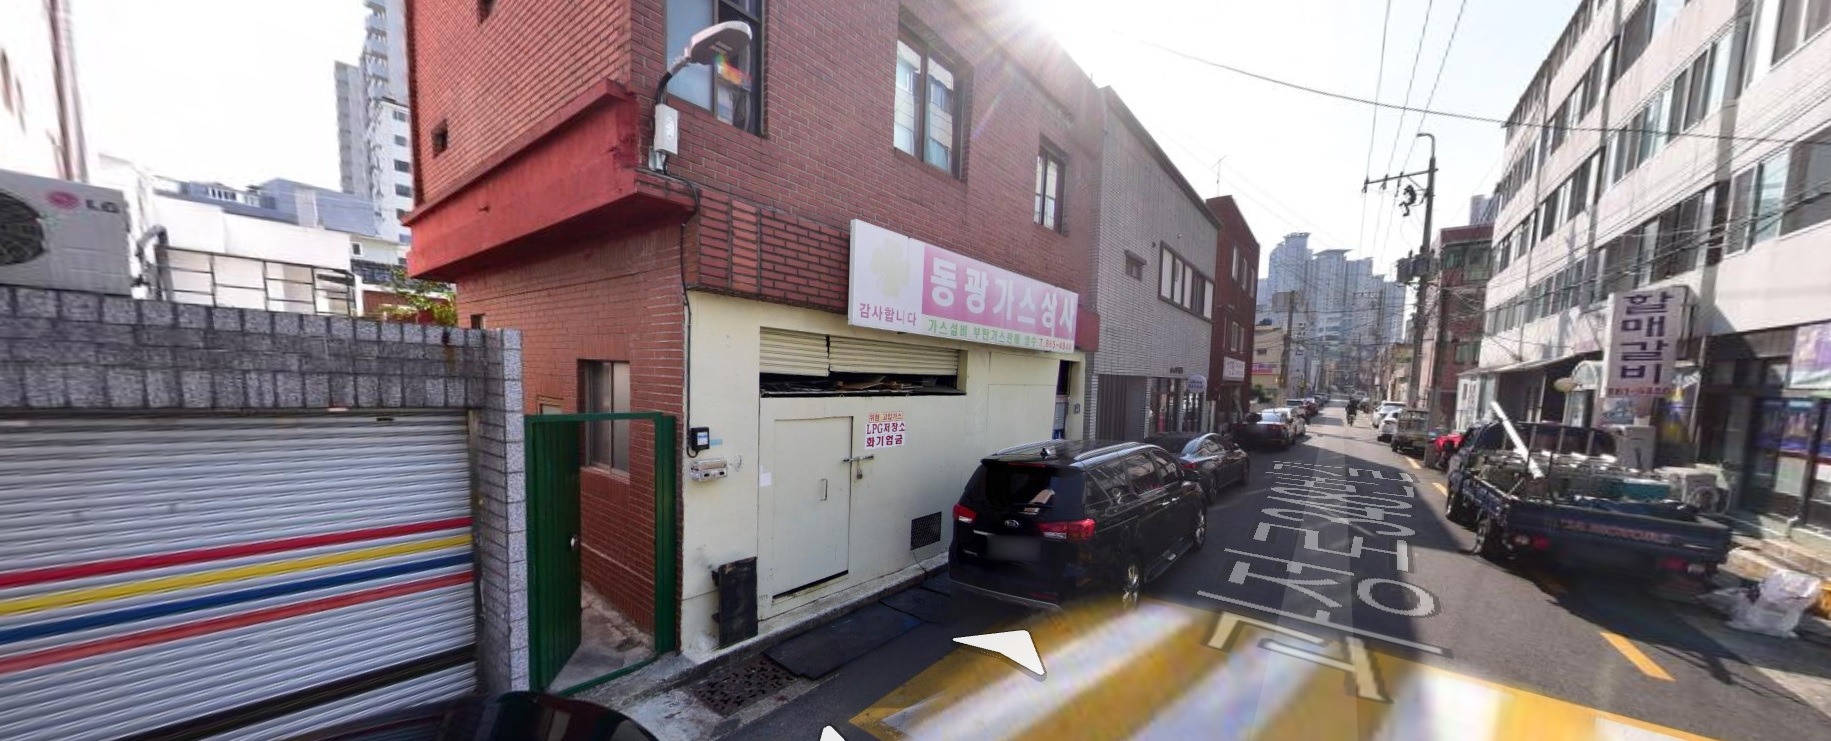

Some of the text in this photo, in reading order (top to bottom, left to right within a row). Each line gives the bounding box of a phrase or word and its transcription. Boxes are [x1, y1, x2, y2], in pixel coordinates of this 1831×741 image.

[86, 200, 119, 213] LG
[930, 256, 1075, 335] 동광가스상사
[859, 302, 917, 326] 감사합니다
[1620, 292, 1674, 384] 할매갈비
[867, 423, 905, 434] LPG저장소
[867, 435, 903, 447] 화기엄금
